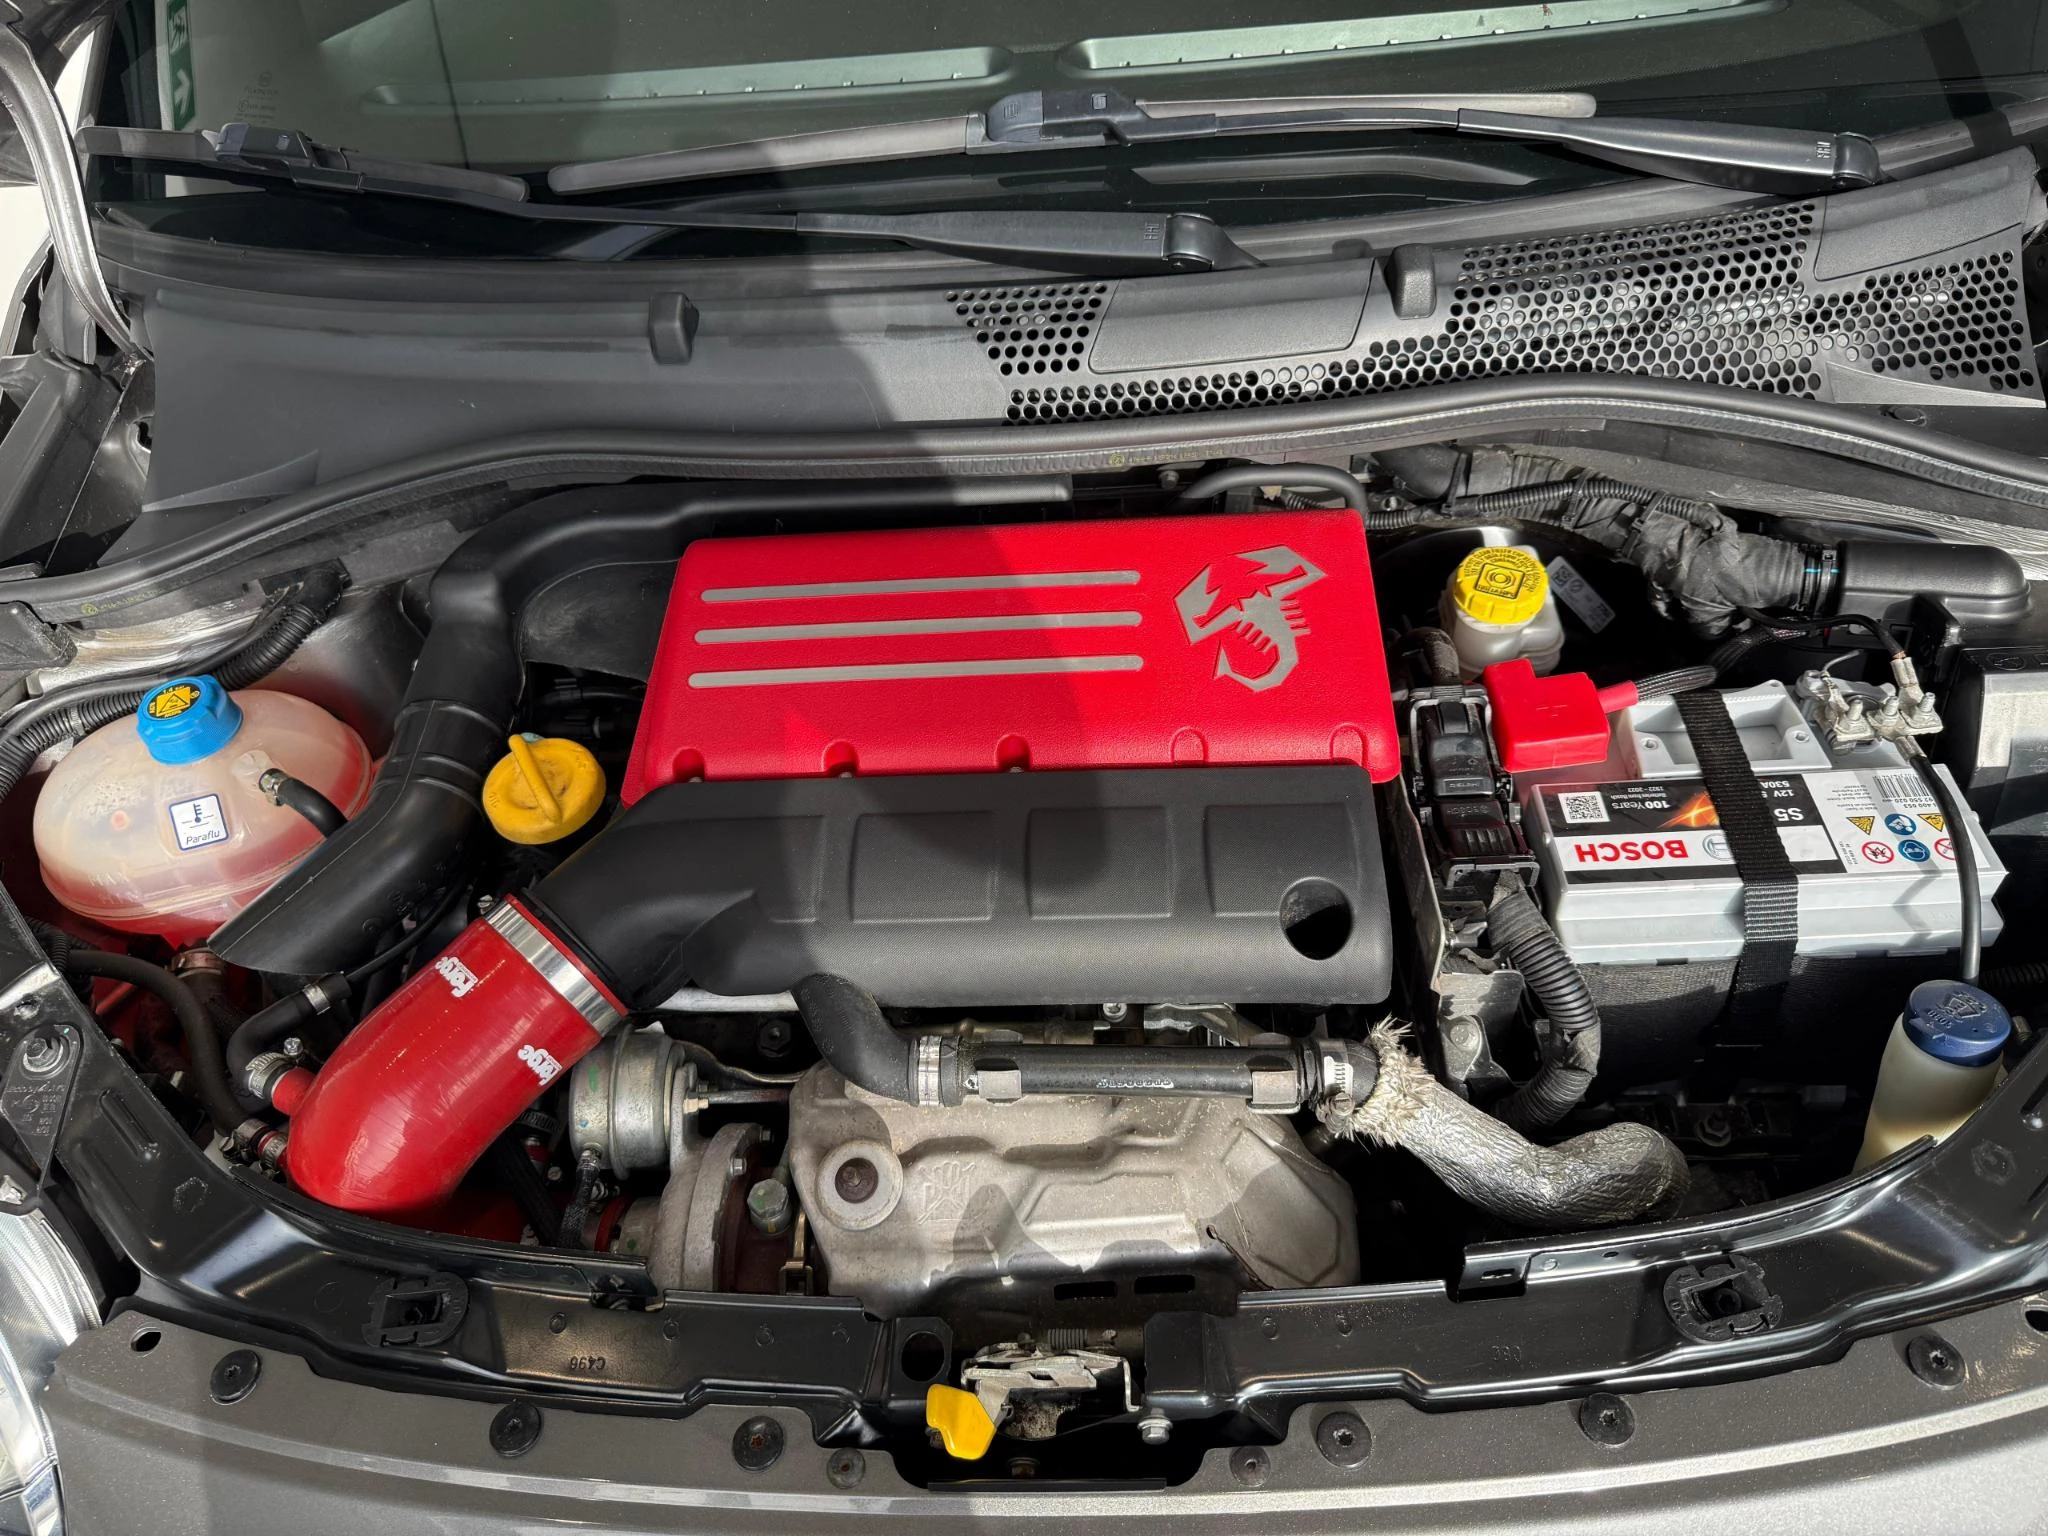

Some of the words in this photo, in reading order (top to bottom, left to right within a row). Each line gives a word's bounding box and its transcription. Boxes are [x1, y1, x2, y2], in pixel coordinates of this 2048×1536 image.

[1760, 780, 1789, 789] 530A
[1773, 789, 1794, 798] 12V
[1612, 801, 1647, 810] Years
[1646, 800, 1671, 809] 100
[1774, 807, 1805, 822] S5
[185, 829, 221, 846] Paraflu
[1574, 840, 1689, 862] BOSCH
[569, 1356, 607, 1371] C496
